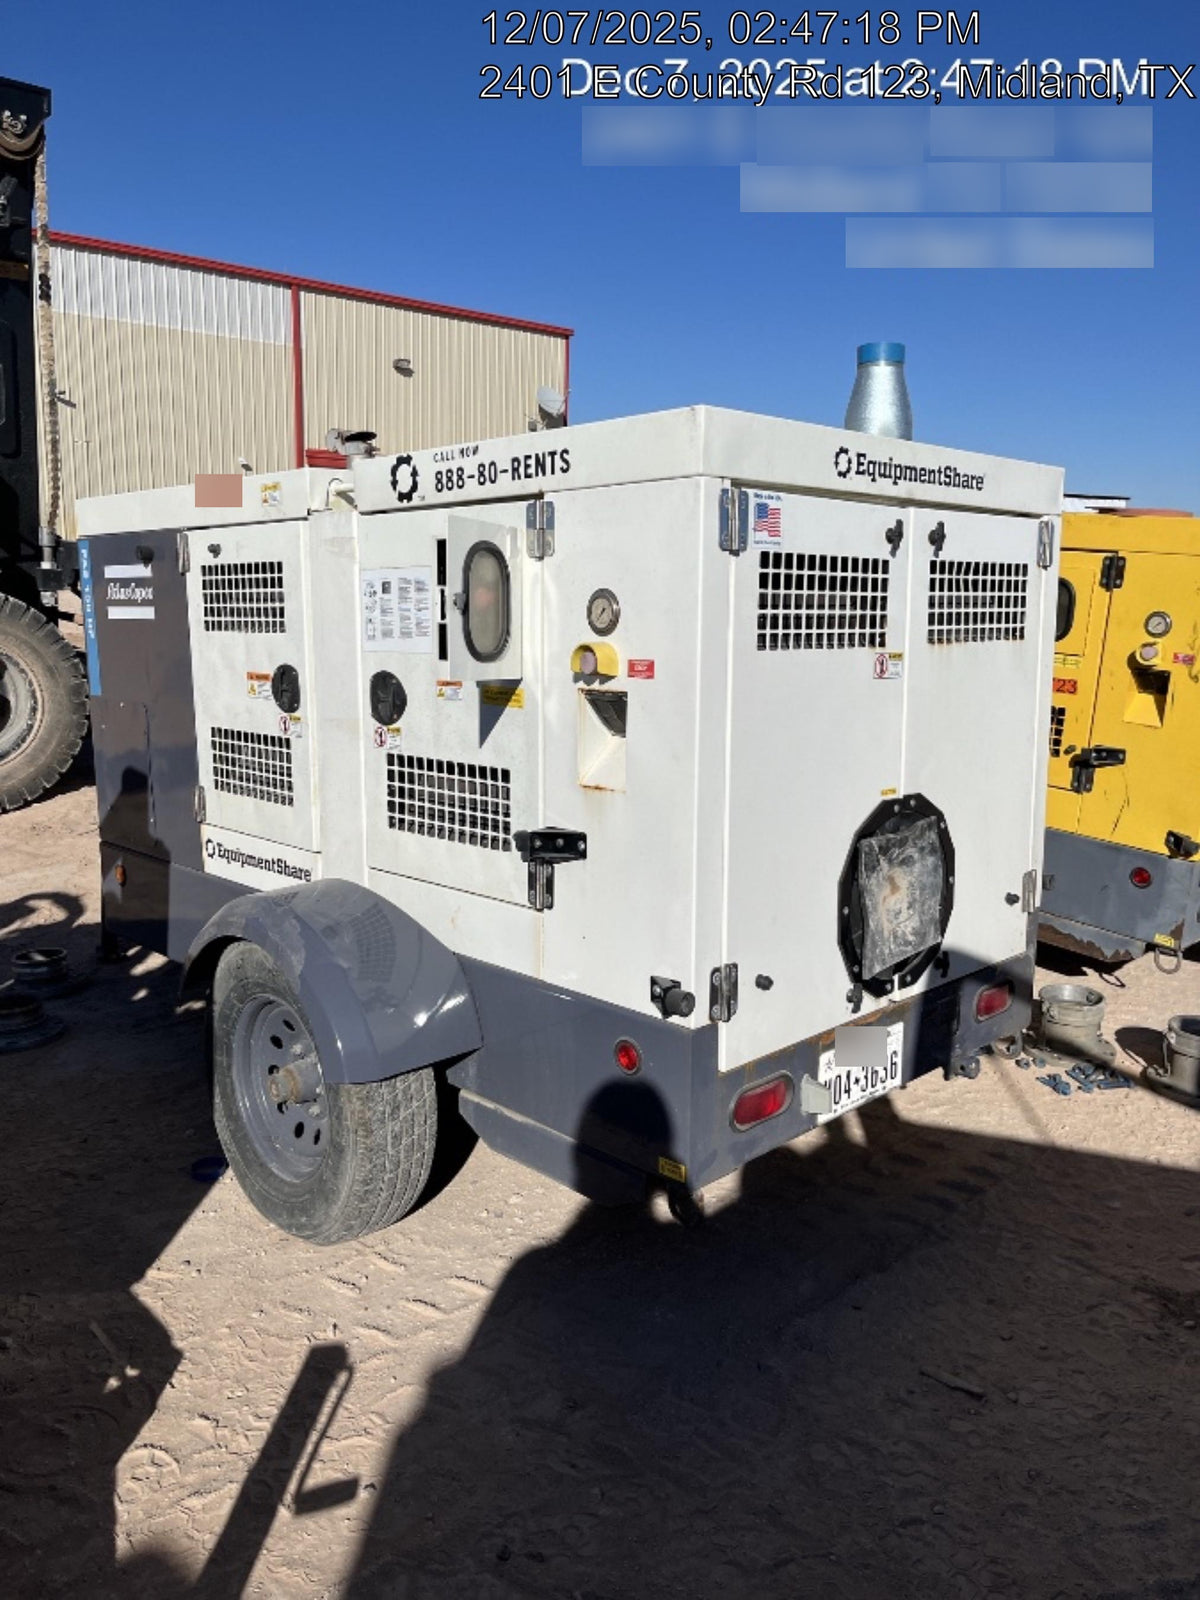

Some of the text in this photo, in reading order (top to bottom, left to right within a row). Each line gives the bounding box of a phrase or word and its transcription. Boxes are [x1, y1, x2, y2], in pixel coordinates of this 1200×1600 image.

[433, 444, 479, 463] CALL NOW
[434, 448, 571, 493] 888-80-RENTS
[855, 452, 985, 491] EquipmentShare
[216, 842, 312, 882] EquipmentShare
